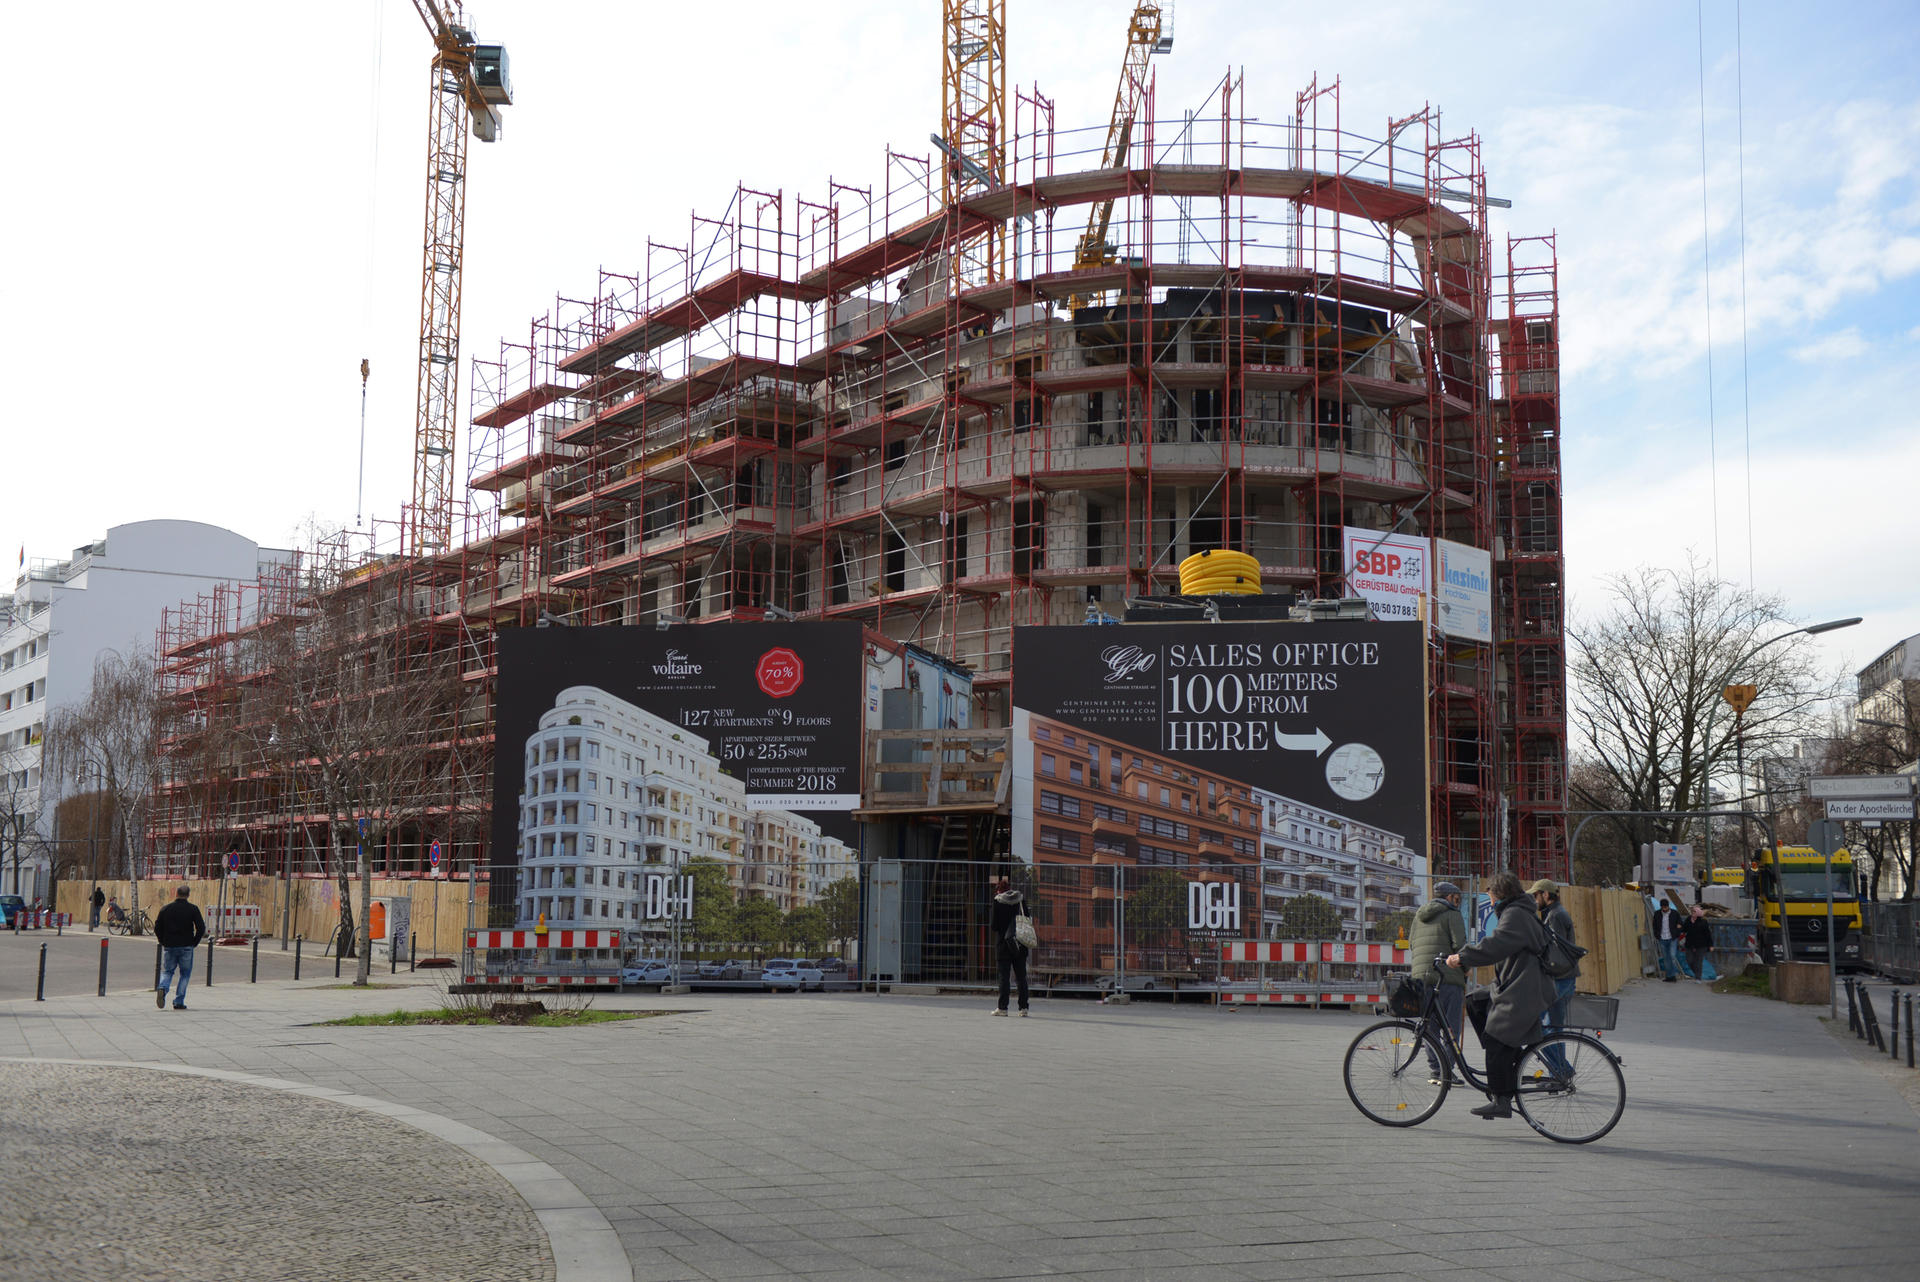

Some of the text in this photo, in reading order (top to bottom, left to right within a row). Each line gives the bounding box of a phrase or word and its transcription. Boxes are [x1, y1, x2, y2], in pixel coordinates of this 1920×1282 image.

[1355, 550, 1401, 577] SBP
[1445, 557, 1488, 592] kasimir
[1355, 578, 1399, 593] GERÜSTBAU
[1368, 602, 1391, 614] 30/50
[1392, 605, 1401, 615] 37
[1402, 606, 1411, 616] 88
[1170, 642, 1379, 667] SALES OFFICE
[652, 659, 702, 675] voltaire
[765, 667, 794, 680] 70%
[1167, 673, 1338, 714] 100 METERS
[1247, 695, 1308, 714] FROM
[684, 708, 793, 726] 127 NEW ON 9
[713, 717, 831, 727] APARTMENTS FLOORS
[1168, 721, 1269, 751] HERE
[724, 744, 808, 760] 50 & 255 SQM
[750, 774, 836, 791] SUMMER 2018
[1829, 803, 1913, 815] An der Apostelkirche
[1188, 882, 1240, 929] D&H
